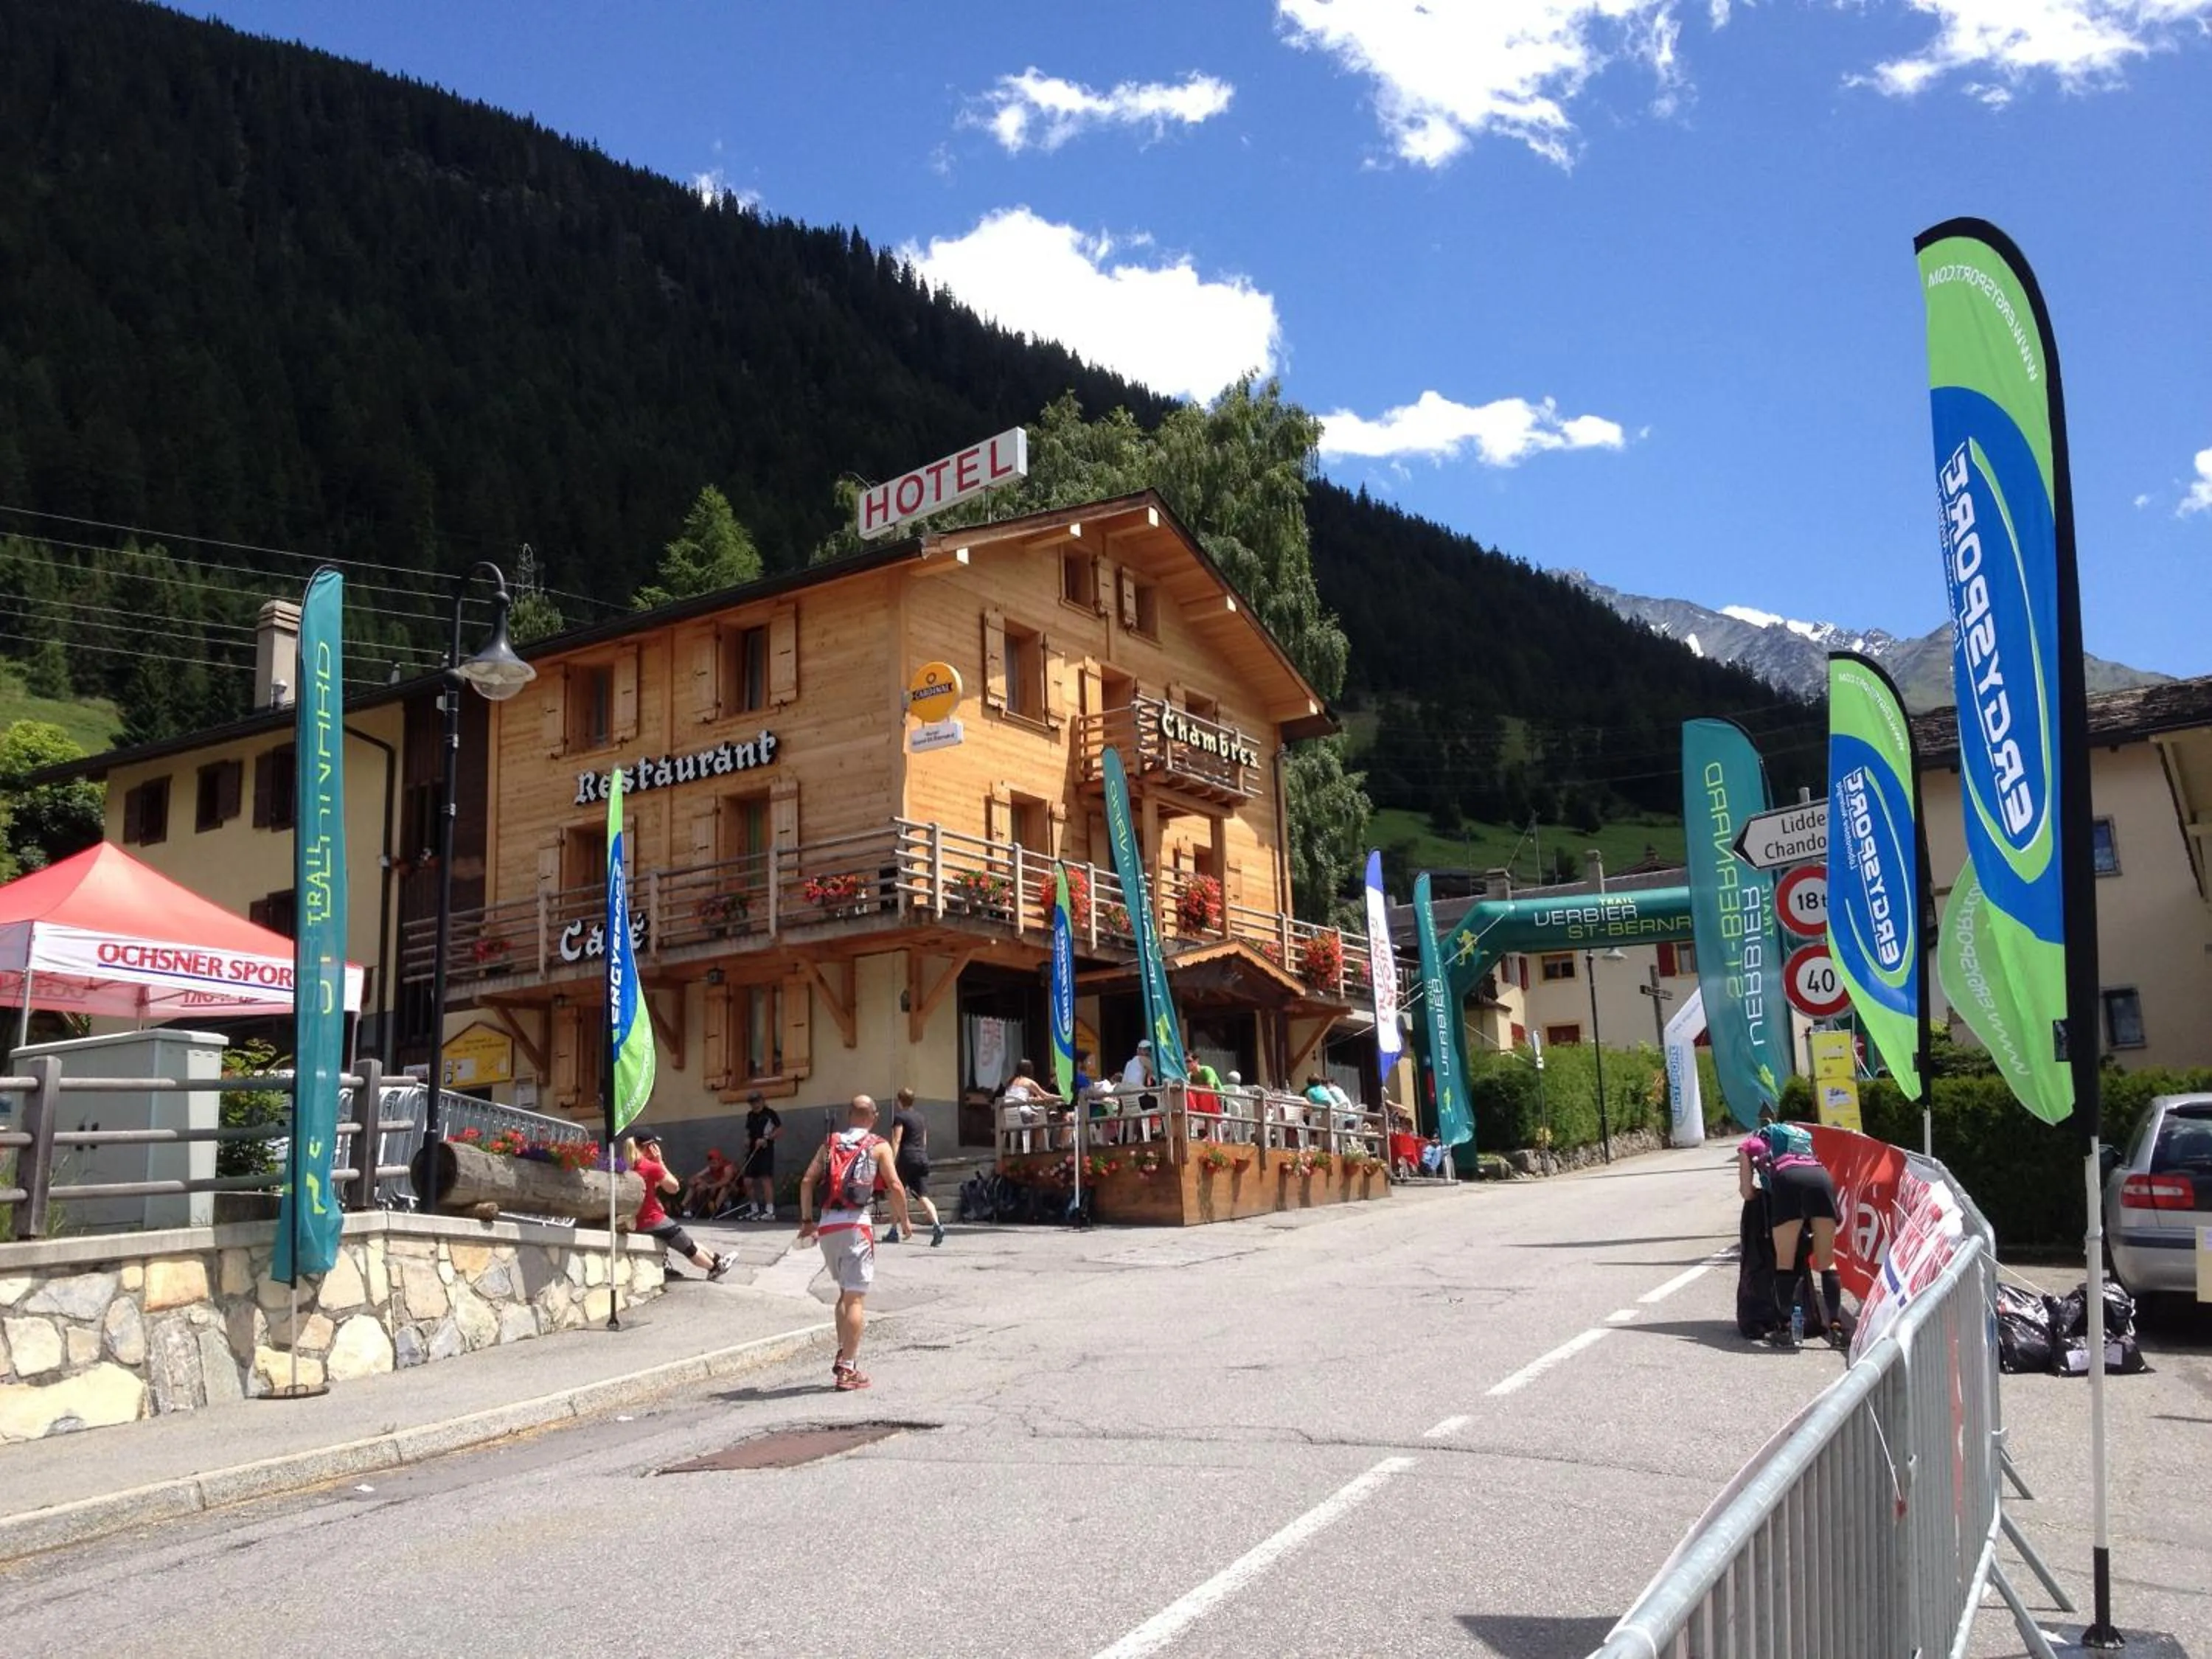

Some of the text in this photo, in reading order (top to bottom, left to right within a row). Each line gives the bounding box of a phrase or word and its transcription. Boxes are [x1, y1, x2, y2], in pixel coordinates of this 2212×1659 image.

[866, 440, 1012, 529] HOTEL
[1162, 712, 1261, 769] Chambres
[575, 730, 776, 804] Restaurant
[1781, 813, 1826, 834] Lidde
[1764, 834, 1827, 859] Chando
[307, 840, 321, 925] TRAIL
[1599, 897, 1635, 905] TRAIL
[1797, 892, 1818, 911] 18
[560, 912, 645, 961] Caé
[1568, 916, 1692, 939] ST-BERNA
[97, 943, 294, 987] OCHSNER SPOR
[1808, 968, 1835, 993] 40
